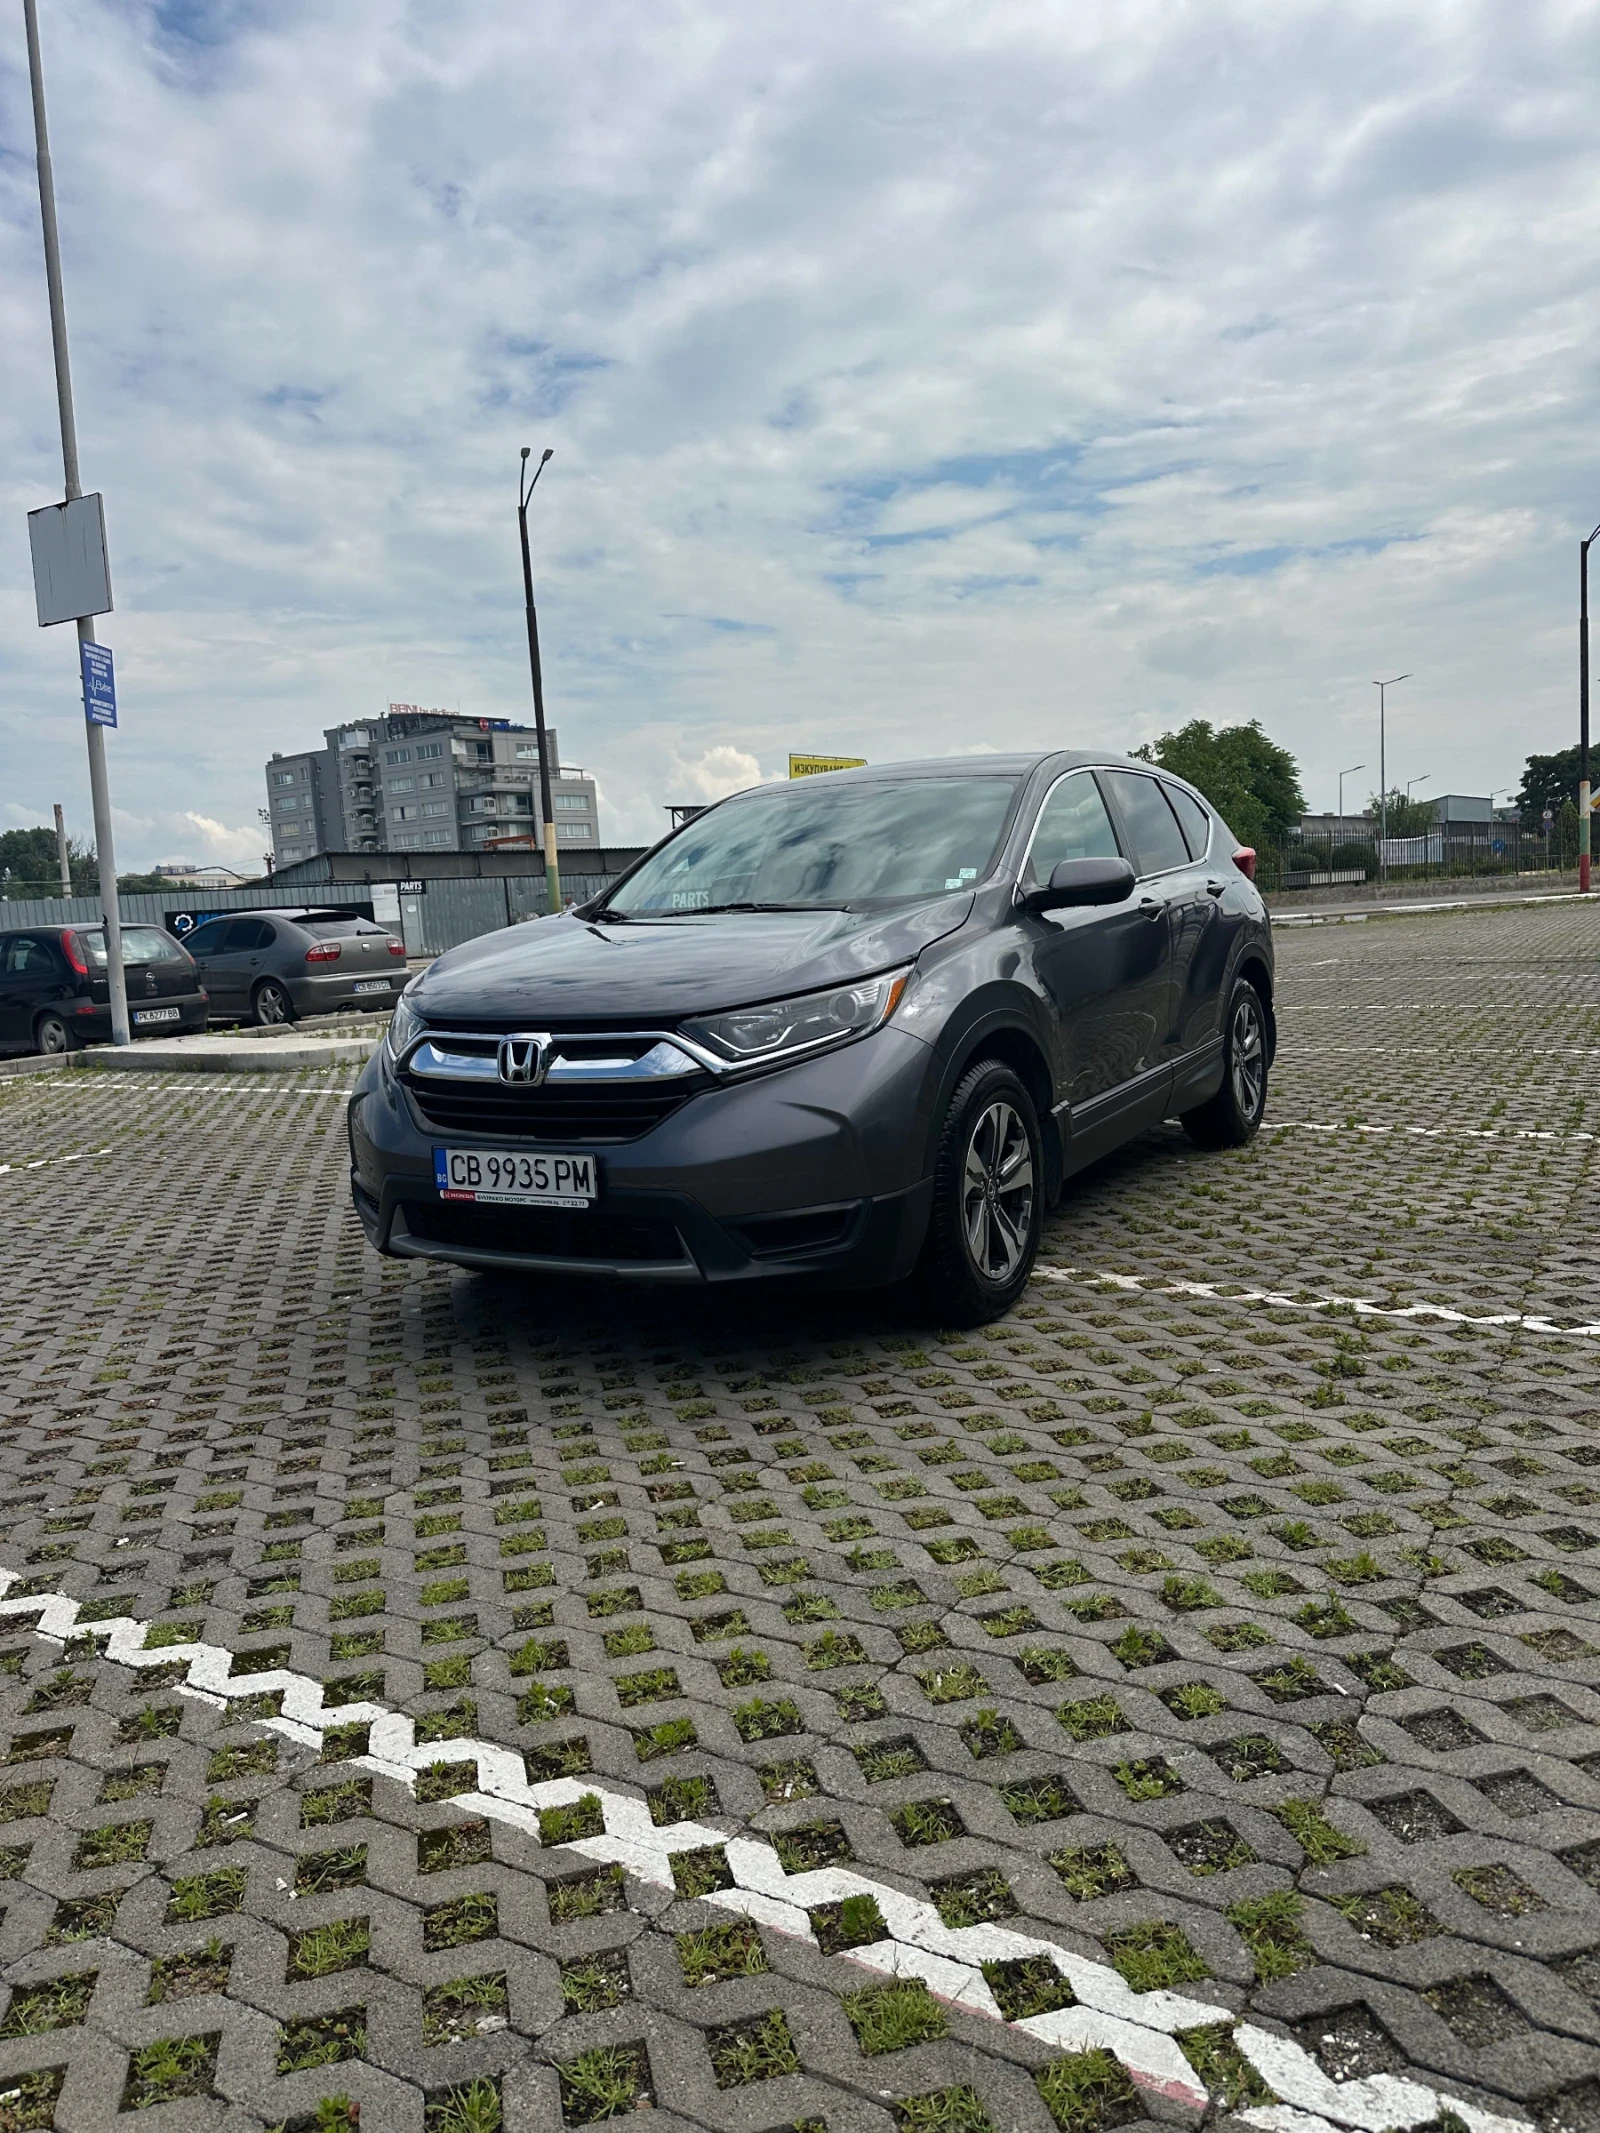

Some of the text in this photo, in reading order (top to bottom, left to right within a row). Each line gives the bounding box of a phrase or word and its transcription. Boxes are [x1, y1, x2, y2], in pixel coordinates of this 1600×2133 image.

[400, 881, 422, 891] PARTS
[672, 891, 709, 909] PARTS
[437, 1173, 447, 1183] BG
[487, 1157, 549, 1190] 9935
